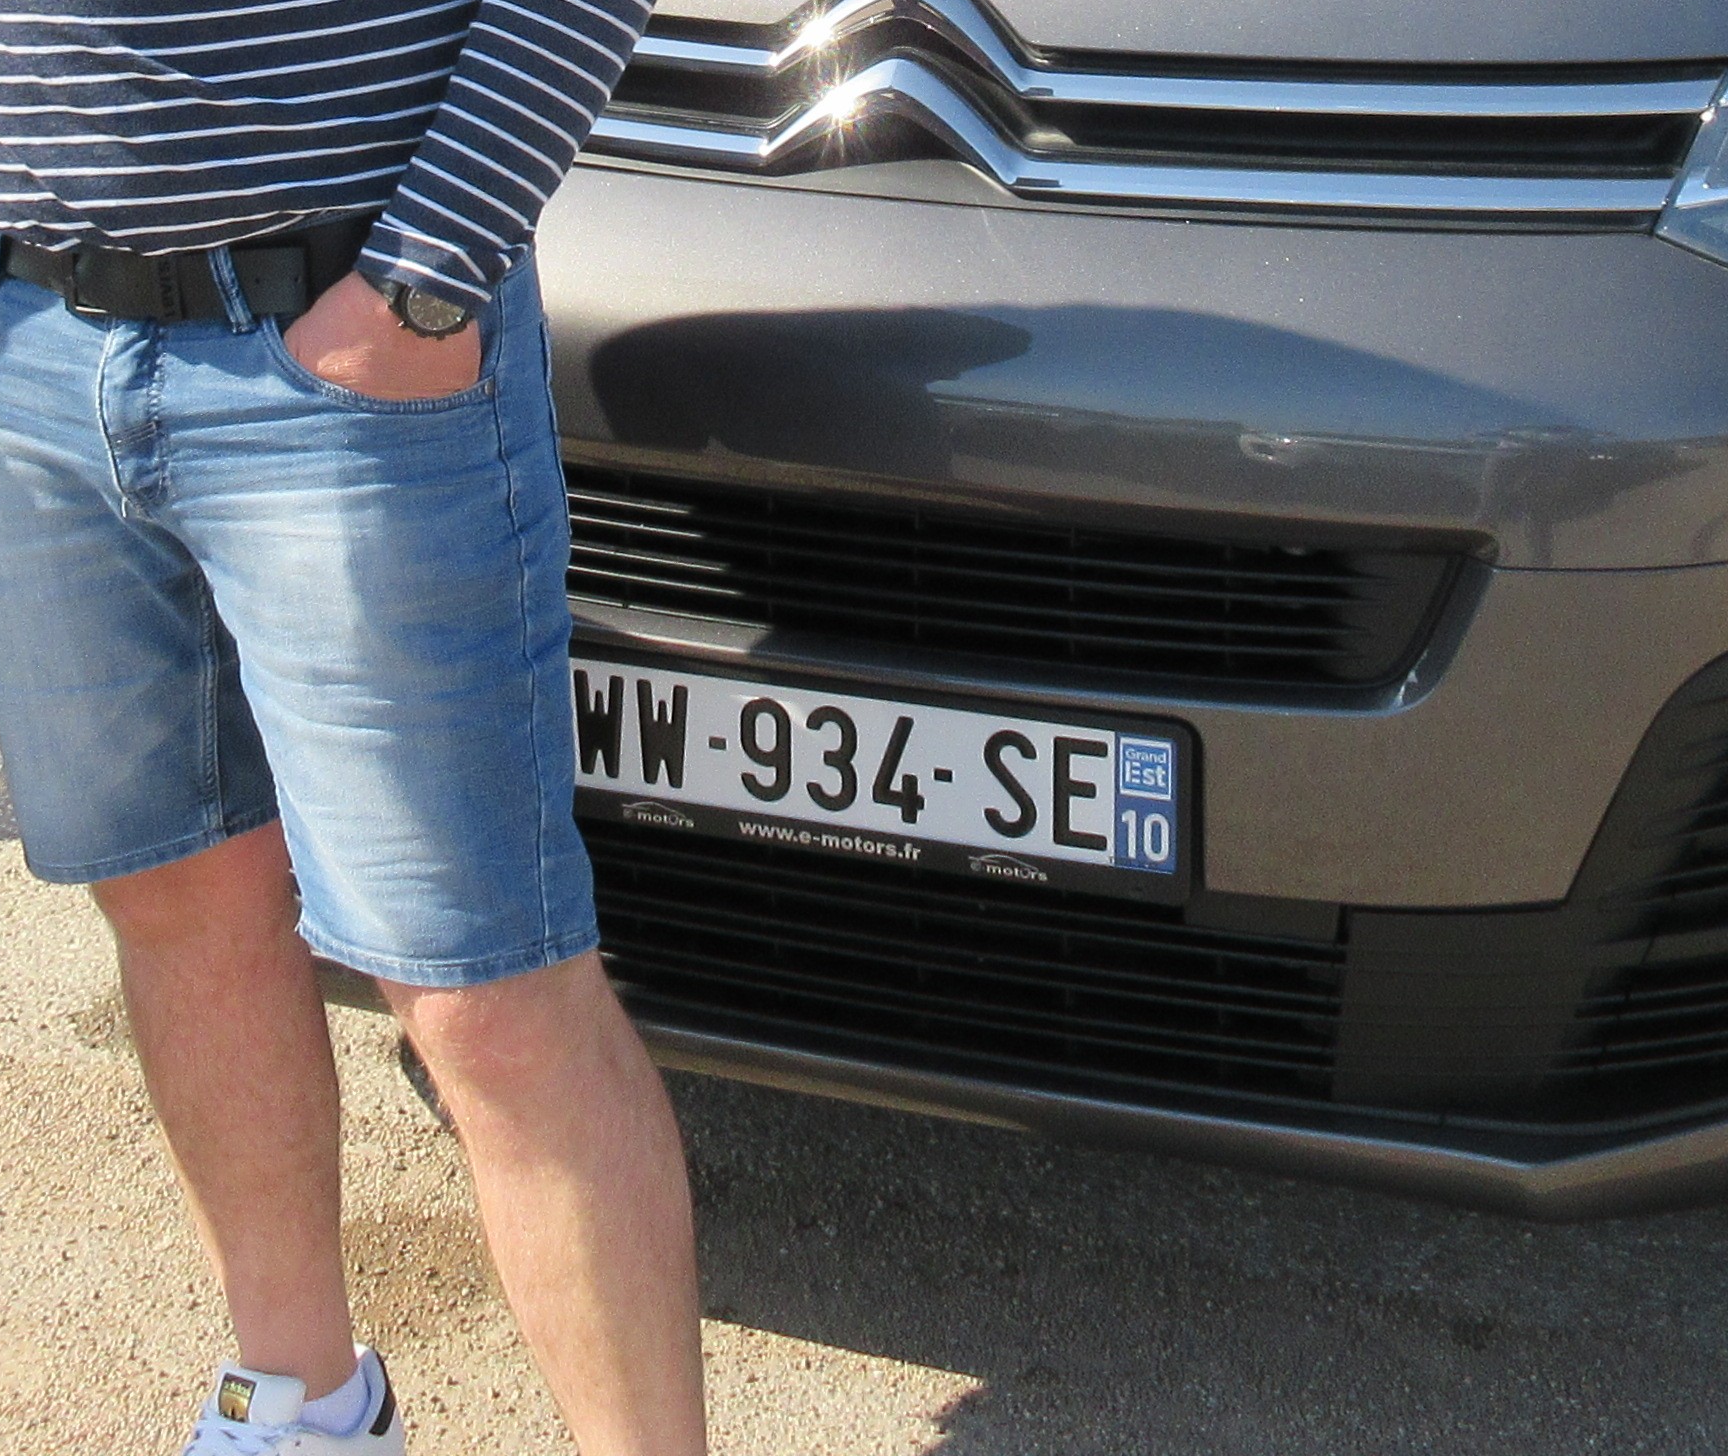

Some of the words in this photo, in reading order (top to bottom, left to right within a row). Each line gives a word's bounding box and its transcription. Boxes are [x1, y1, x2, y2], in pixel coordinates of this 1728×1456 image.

[573, 669, 1109, 851] WW-934-SE
[1125, 748, 1167, 764] Grand
[1125, 760, 1166, 787] Est
[739, 819, 921, 862] www.e-motors.fr
[1122, 810, 1170, 862] 10
